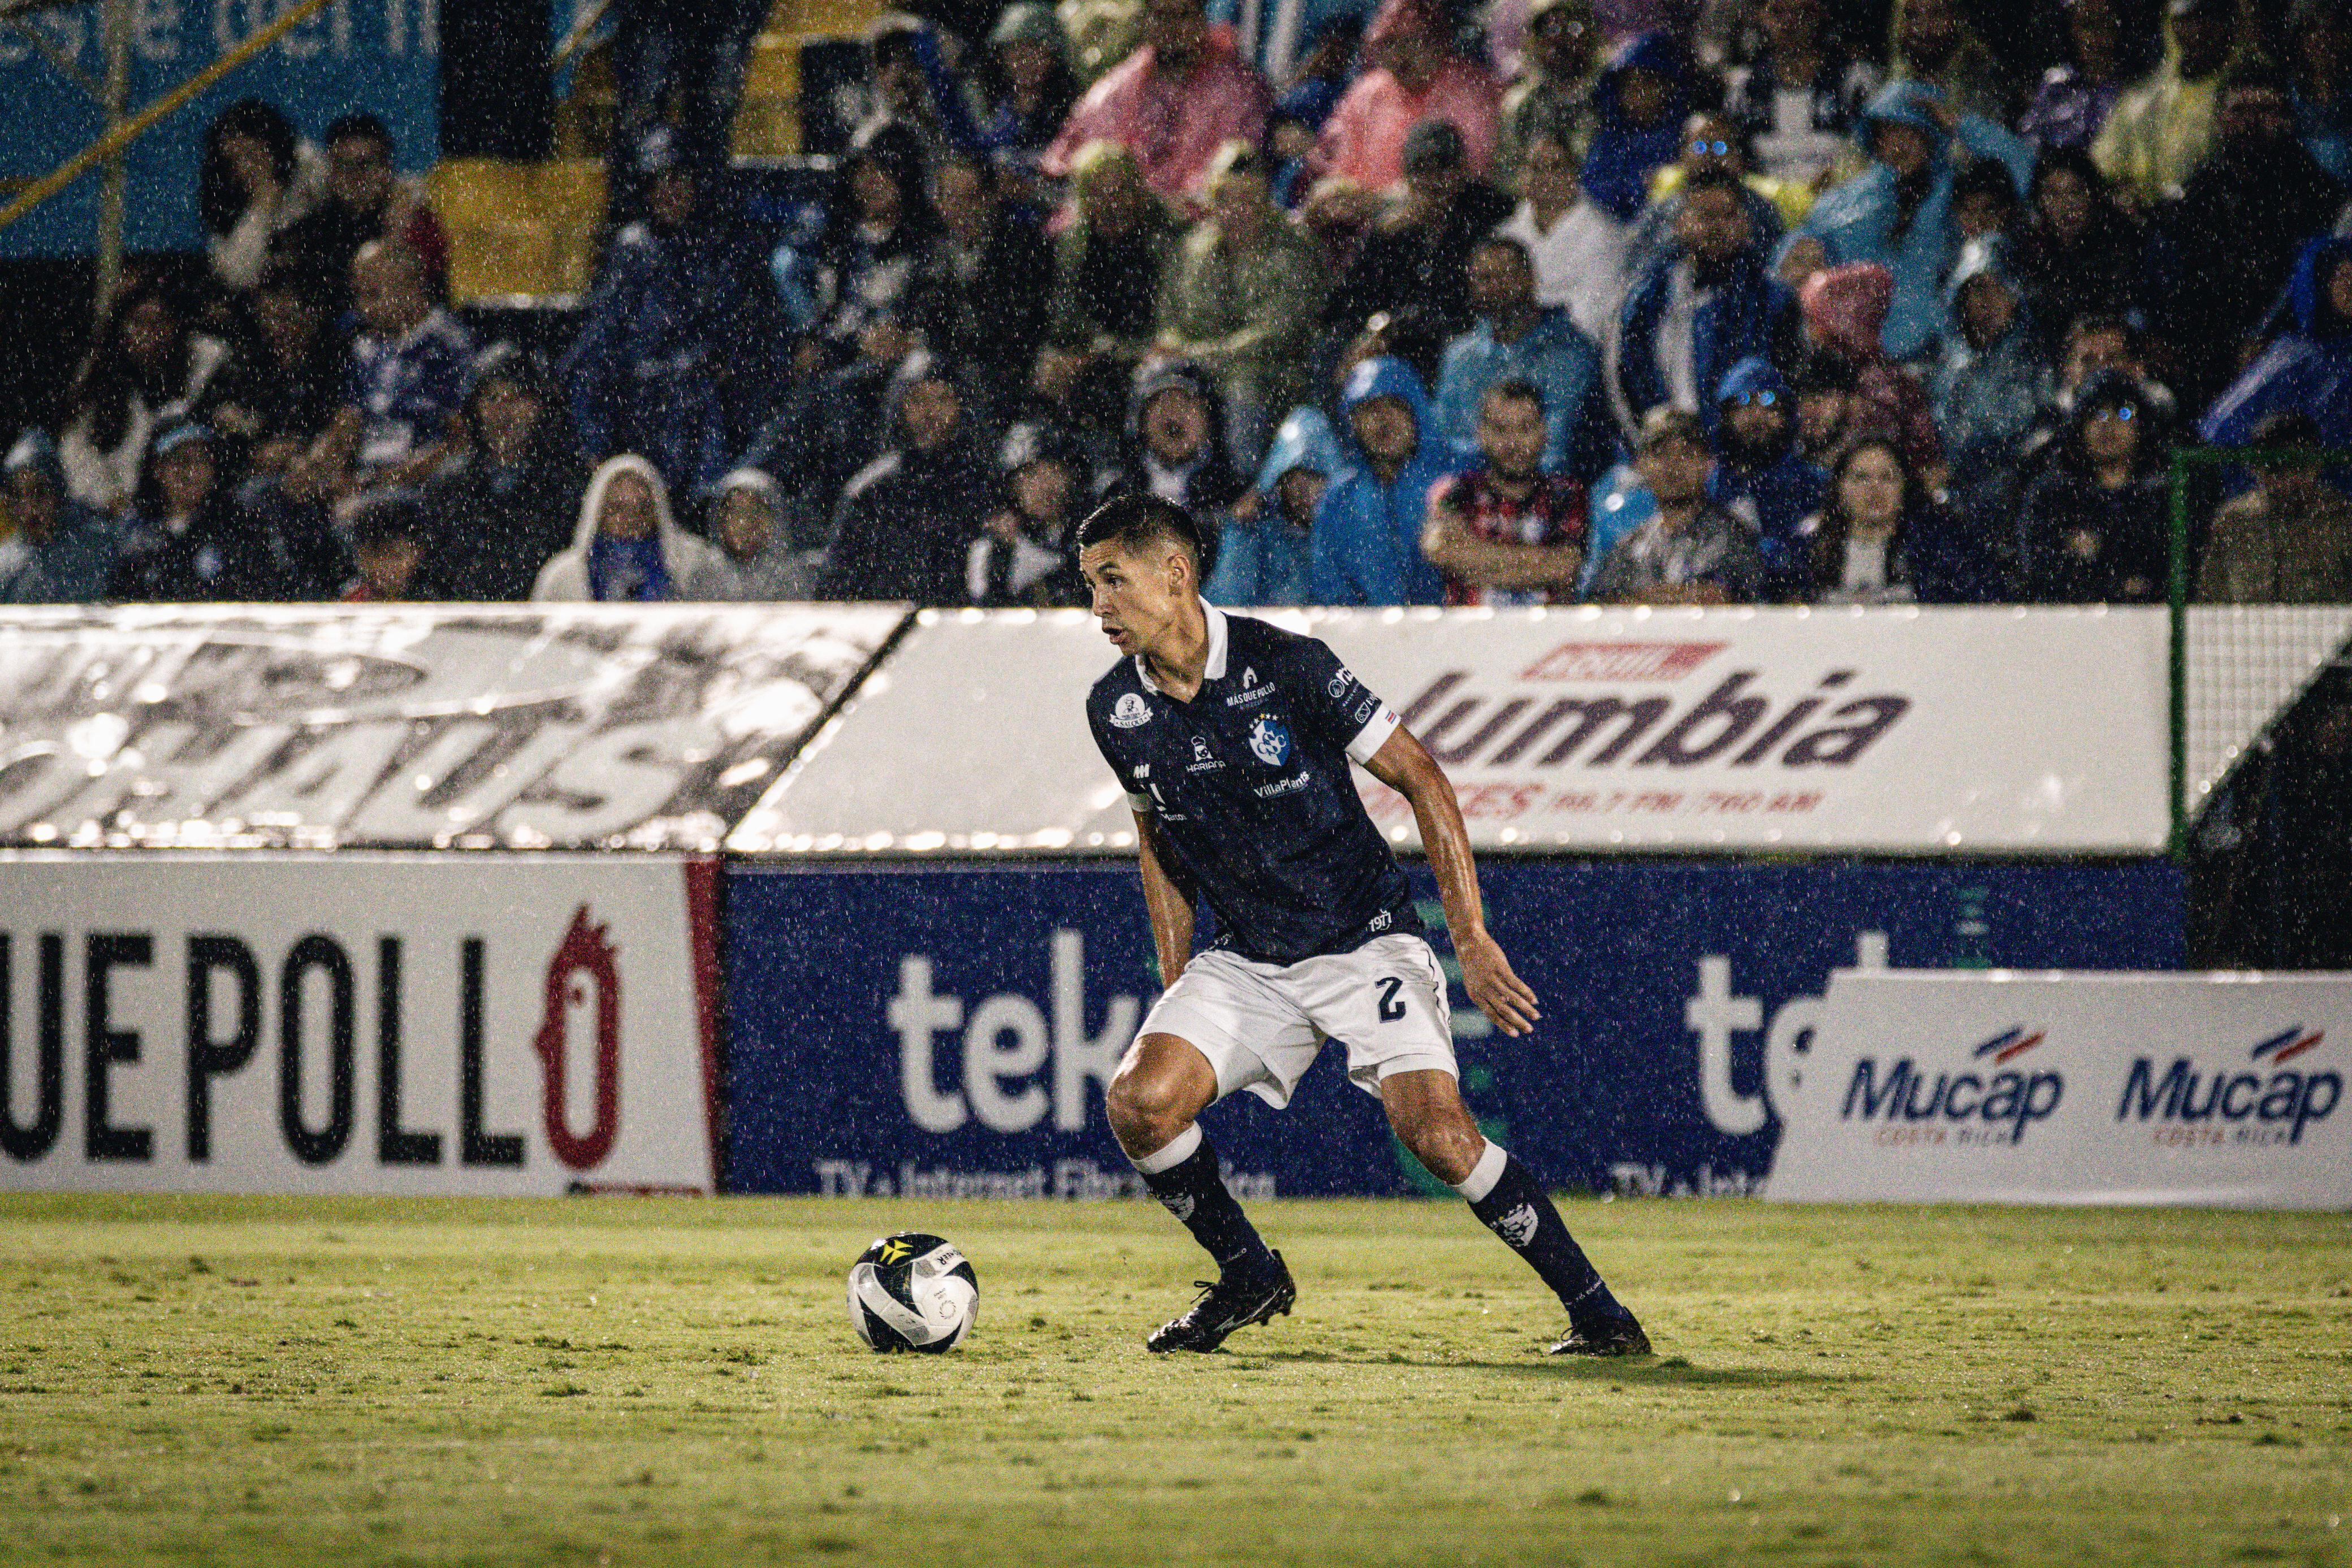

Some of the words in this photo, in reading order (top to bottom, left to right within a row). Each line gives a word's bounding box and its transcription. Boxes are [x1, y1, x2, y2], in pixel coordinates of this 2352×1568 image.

[1253, 770, 1309, 798] VillaPlants
[1374, 976, 1406, 1023] 2
[812, 1159, 870, 1197] TV
